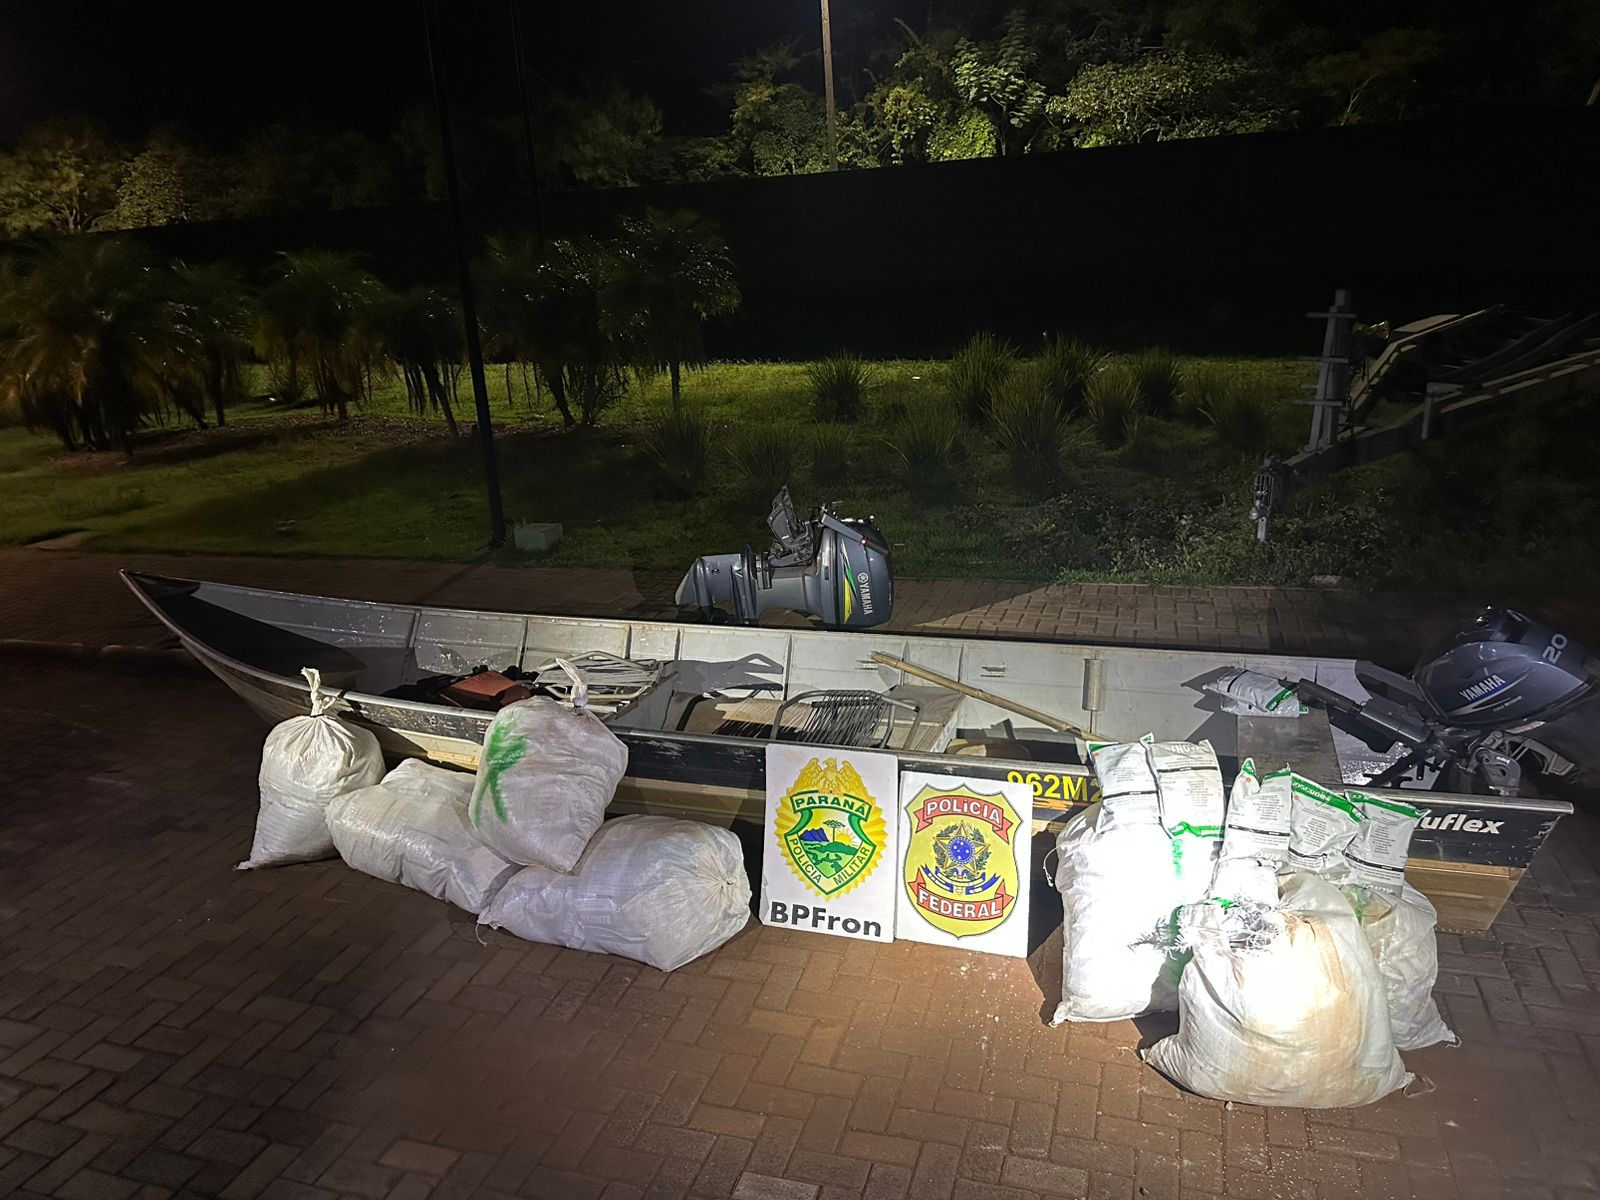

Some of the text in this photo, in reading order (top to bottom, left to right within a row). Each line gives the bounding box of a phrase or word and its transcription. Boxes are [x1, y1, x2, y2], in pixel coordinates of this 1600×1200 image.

[859, 582, 874, 615] YAMAHA
[1542, 633, 1568, 664] 20
[1460, 674, 1506, 701] YAMAHA
[795, 795, 867, 816] PARANÁ
[1414, 814, 1505, 835] uflex
[832, 846, 871, 885] MILITAR
[918, 889, 1002, 918] FEDERAL
[769, 901, 882, 937] BPFron
